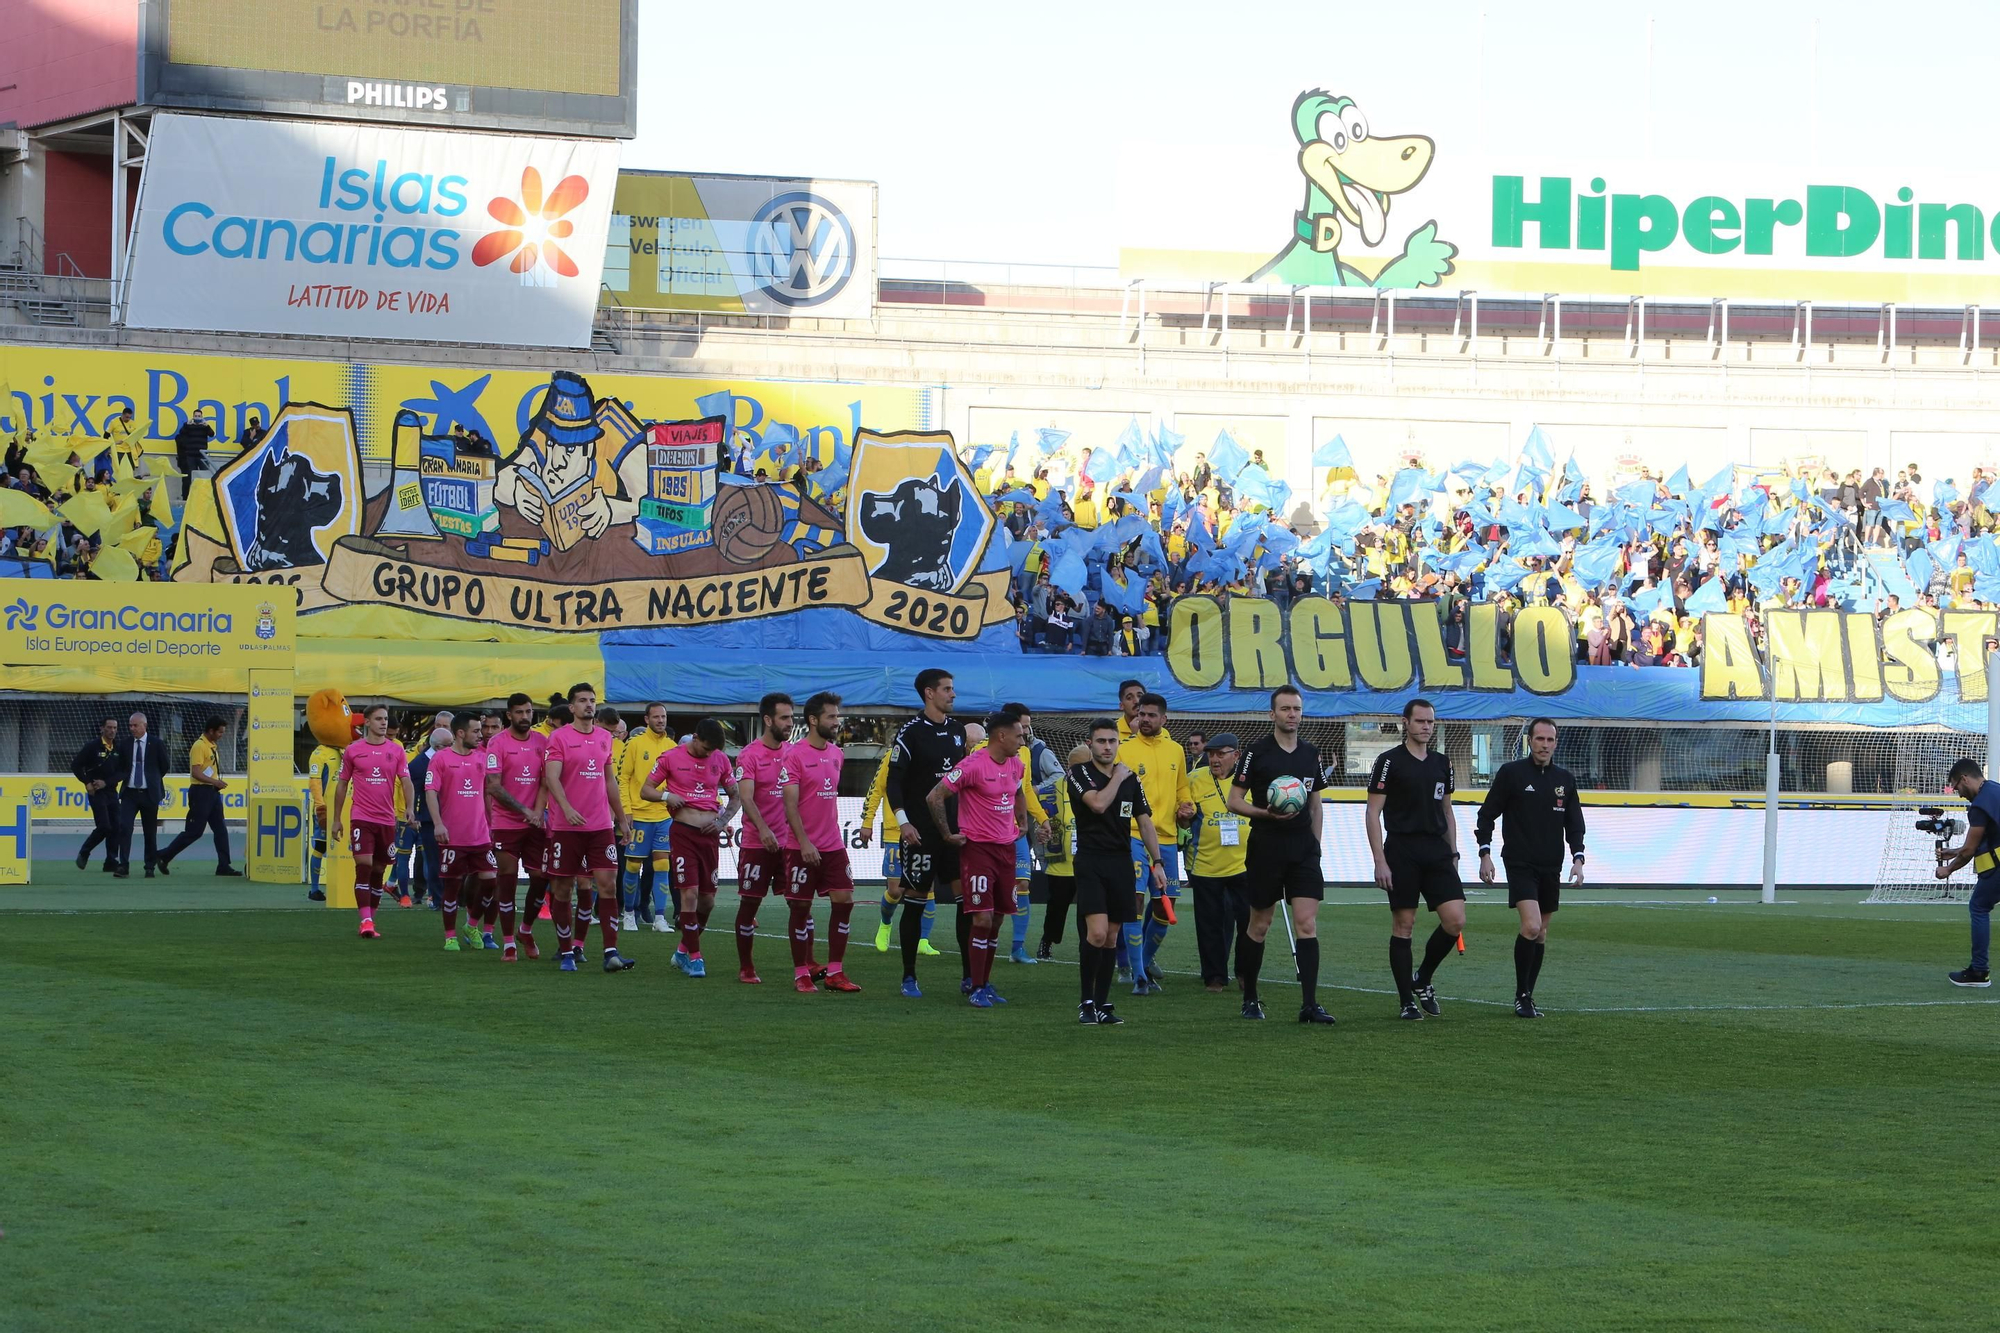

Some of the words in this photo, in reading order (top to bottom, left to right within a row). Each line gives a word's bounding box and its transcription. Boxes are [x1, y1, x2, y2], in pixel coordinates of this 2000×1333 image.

[317, 6, 357, 32] LA
[347, 81, 448, 110] PHILIPS
[319, 156, 469, 217] Islas
[1491, 174, 2000, 271] HiperDin
[162, 201, 461, 271] Canarias
[660, 266, 722, 284] Oficial
[287, 284, 369, 310] LATITUD
[378, 290, 401, 312] DE
[408, 290, 449, 314] VIDA
[671, 429, 707, 441] VIAJES
[422, 459, 444, 473] GRAN
[447, 459, 480, 475] NARIA
[428, 481, 470, 511] FÚTBOL
[662, 476, 688, 497] 1985
[656, 505, 684, 521] TIFOS
[373, 562, 485, 616] GRUPO
[510, 586, 623, 626] ULTRA
[648, 566, 831, 621] NACIENTE
[45, 603, 232, 633] GranCanaria
[884, 590, 969, 634] 2020
[26, 636, 50, 651] Isla
[55, 637, 122, 655] Europea
[126, 638, 151, 654] del
[156, 640, 221, 657] Deporte
[1167, 595, 1576, 694] ORGULLO
[256, 804, 302, 858] HP
[353, 828, 360, 841] 9
[441, 848, 456, 864] 19
[553, 842, 561, 858] 3
[676, 857, 685, 872] 2
[743, 863, 761, 881] 14
[911, 854, 931, 871] 25
[791, 866, 808, 883] 16
[970, 875, 988, 893] 10
